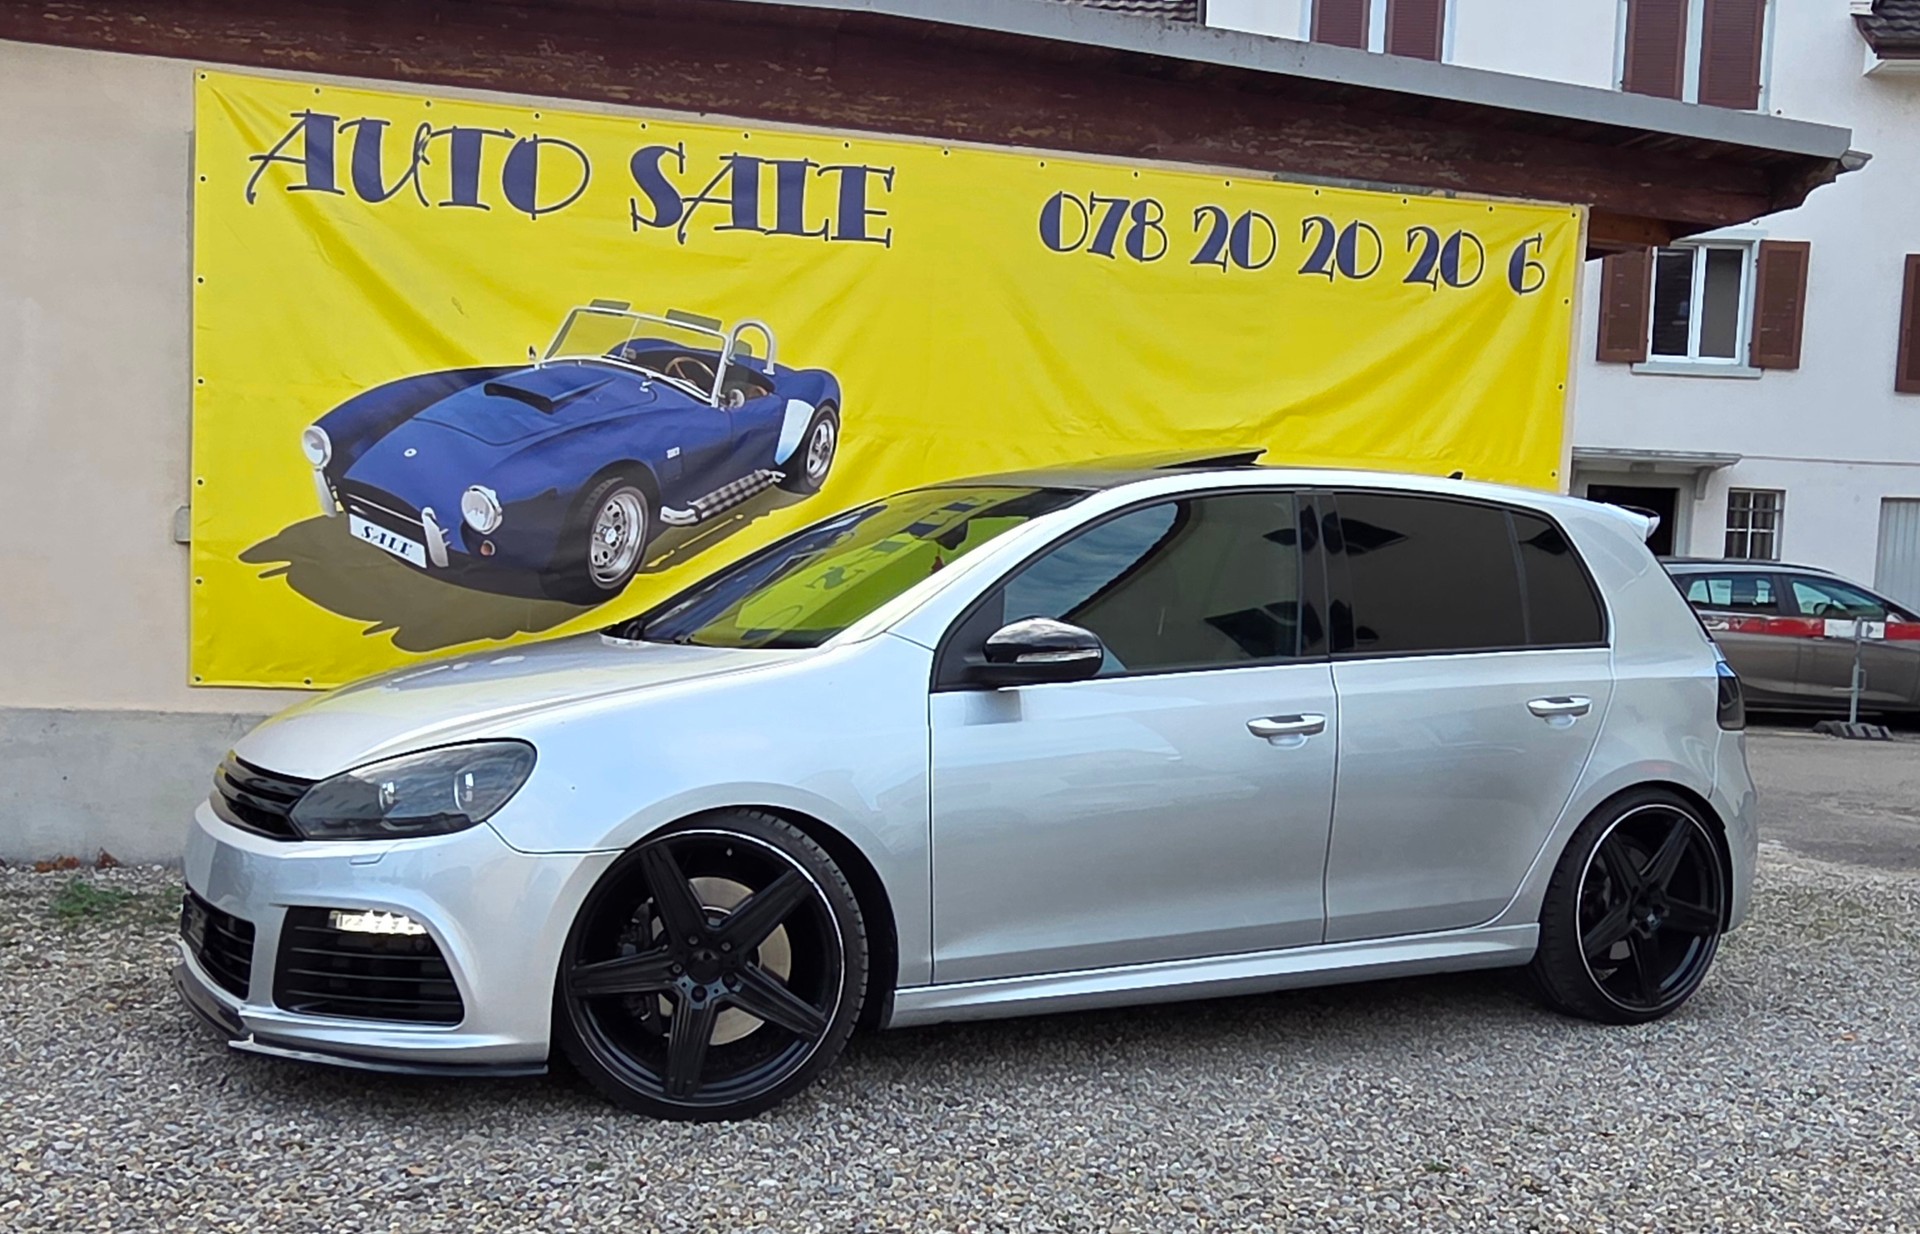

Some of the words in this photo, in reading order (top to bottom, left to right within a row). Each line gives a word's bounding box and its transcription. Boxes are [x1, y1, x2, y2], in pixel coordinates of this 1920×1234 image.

[247, 109, 590, 220] AUTO
[630, 141, 896, 248] SALE
[1039, 190, 1168, 263] 078
[1190, 205, 1277, 273] 20
[1298, 216, 1382, 282] 20
[1402, 226, 1485, 292] 20
[1508, 232, 1546, 295] 6
[361, 525, 413, 556] SALE
